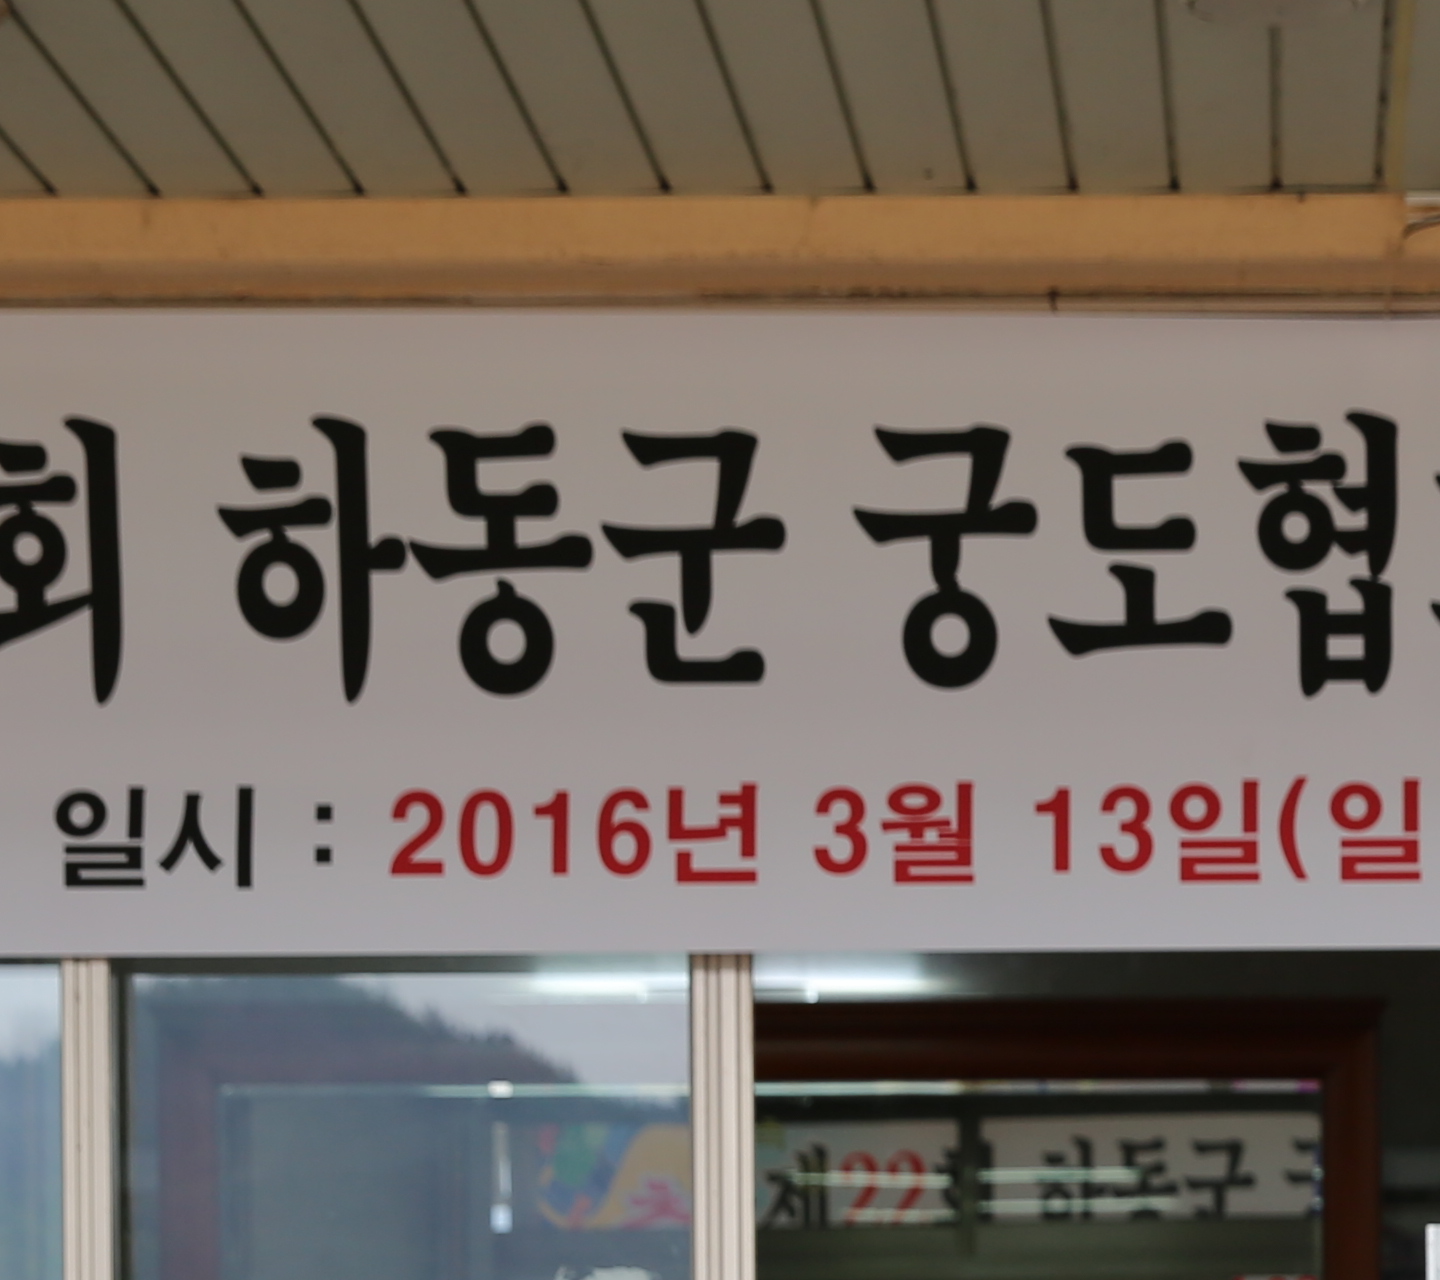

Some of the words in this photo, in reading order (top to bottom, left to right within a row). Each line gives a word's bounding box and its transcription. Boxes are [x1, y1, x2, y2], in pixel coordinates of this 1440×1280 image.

[217, 415, 786, 703] 하동군
[55, 787, 255, 887] 일시
[389, 784, 759, 884] 2016년
[812, 782, 975, 885] 3월
